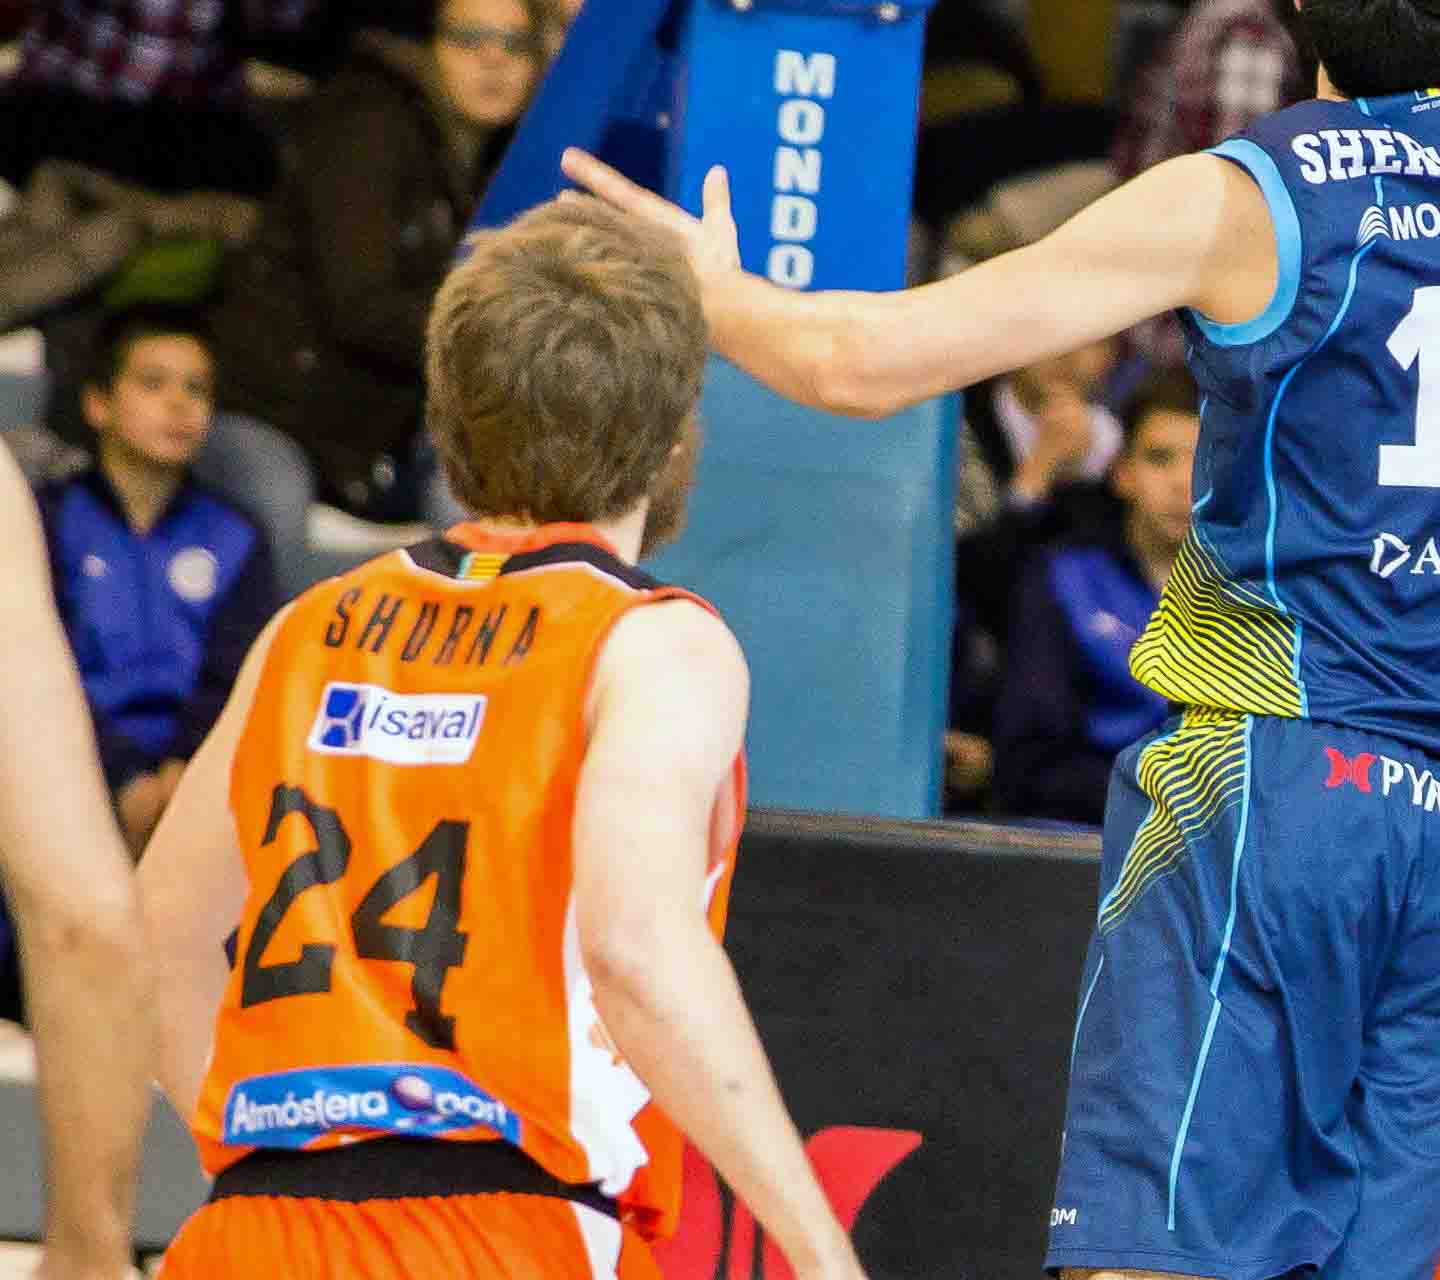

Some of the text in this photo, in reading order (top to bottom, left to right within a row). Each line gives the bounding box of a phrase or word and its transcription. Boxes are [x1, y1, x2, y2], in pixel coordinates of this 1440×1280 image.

[766, 49, 835, 290] MONDO
[324, 587, 540, 668] SHURNA
[369, 696, 481, 740] isaval
[239, 782, 471, 1051] 24
